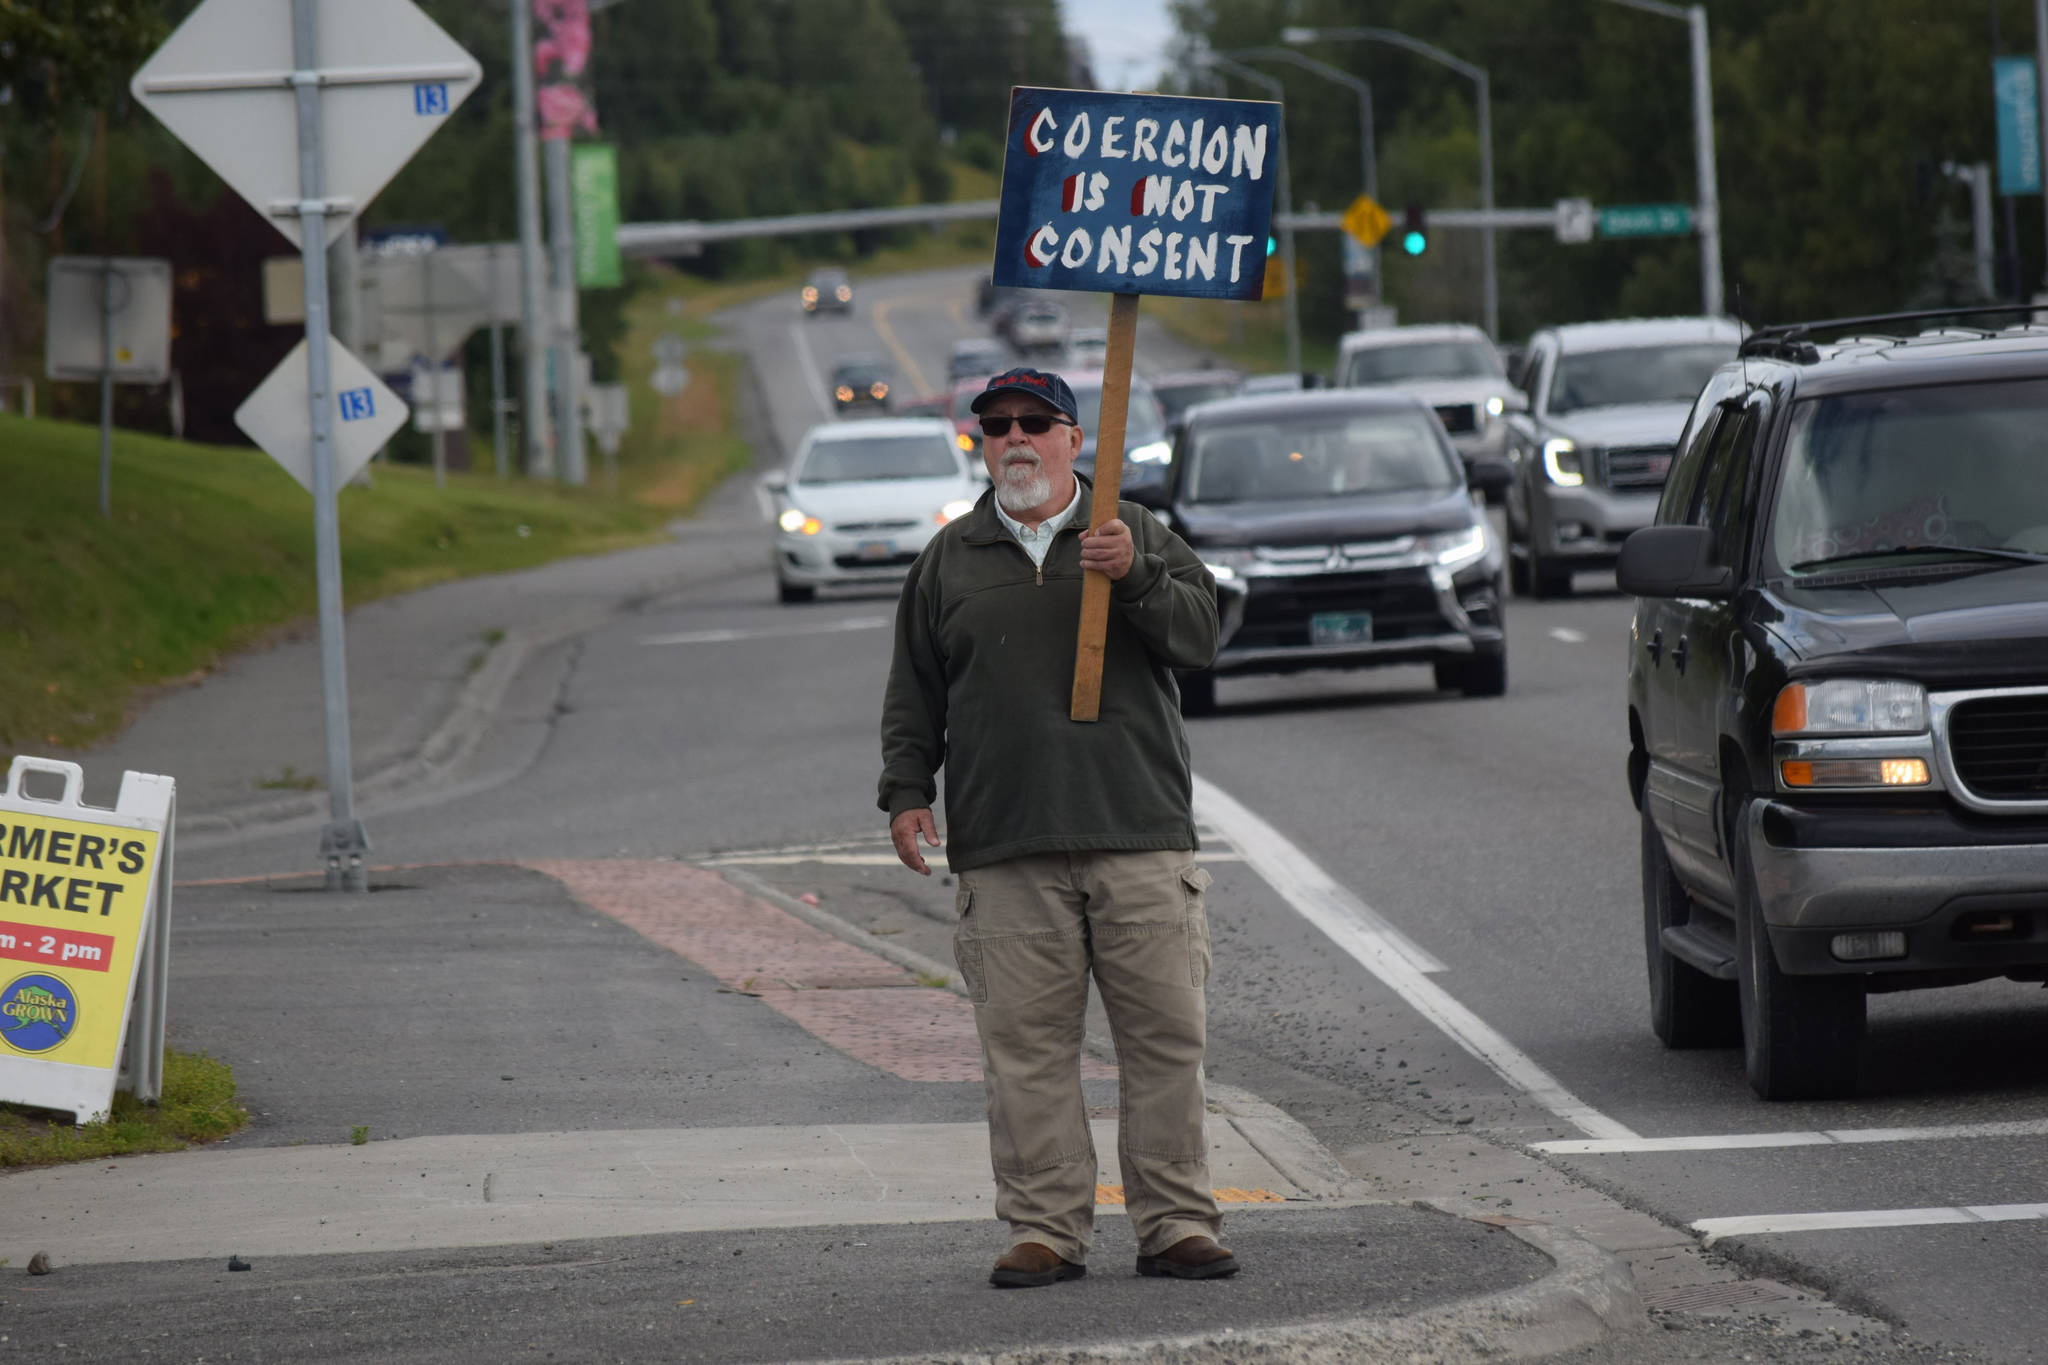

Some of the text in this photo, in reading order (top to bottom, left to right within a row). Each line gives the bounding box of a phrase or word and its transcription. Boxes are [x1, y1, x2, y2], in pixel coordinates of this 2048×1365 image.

[421, 86, 445, 114] 13
[1024, 107, 1267, 180] COERCION
[1062, 171, 1230, 222] IS NOT
[1024, 222, 1254, 283] CONSENT
[344, 391, 370, 420] 13
[0, 823, 146, 875] MER'S
[38, 935, 56, 954] 2
[62, 943, 102, 961] pm
[2, 1001, 68, 1023] GROWN
[14, 988, 67, 1009] Alaska
